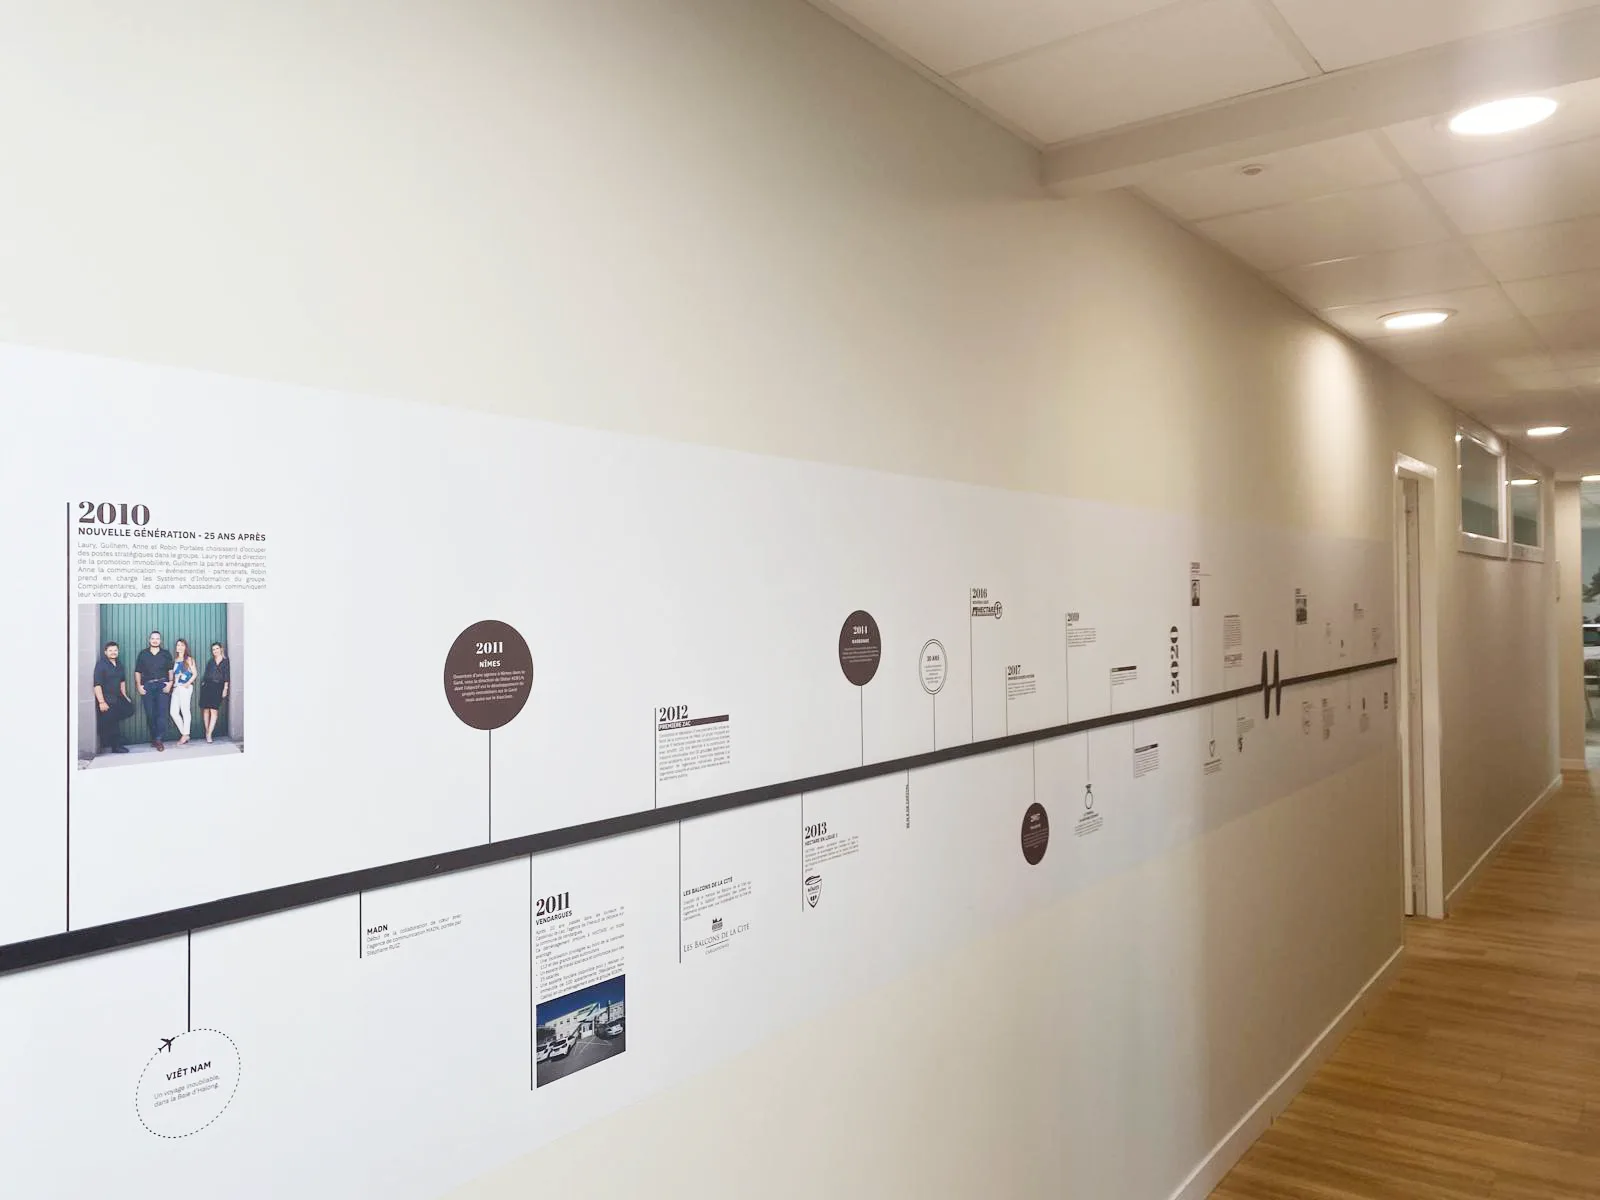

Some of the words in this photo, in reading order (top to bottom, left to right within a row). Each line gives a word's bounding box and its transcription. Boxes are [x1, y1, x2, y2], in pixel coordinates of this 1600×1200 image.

[78, 501, 150, 526] 2010
[78, 527, 131, 537] NOUVELLE
[133, 527, 196, 539] GÉNÉRATION
[204, 532, 215, 540] 25
[217, 532, 236, 541] ANS
[238, 532, 266, 542] APRÈS
[476, 641, 504, 654] 2011
[479, 659, 501, 668] NÎMES
[660, 704, 688, 722] 2012
[804, 822, 827, 840] 2013
[692, 884, 710, 894] BALCONS
[536, 892, 570, 916] 2011
[536, 910, 572, 926] VENDARGUES
[367, 924, 388, 935] MADN
[684, 944, 693, 952] LES
[694, 934, 720, 948] BALCONS
[166, 1068, 188, 1080] VIÊT
[190, 1061, 211, 1074] NAM
[164, 1085, 185, 1096] voyage
[154, 1100, 169, 1108] dans
